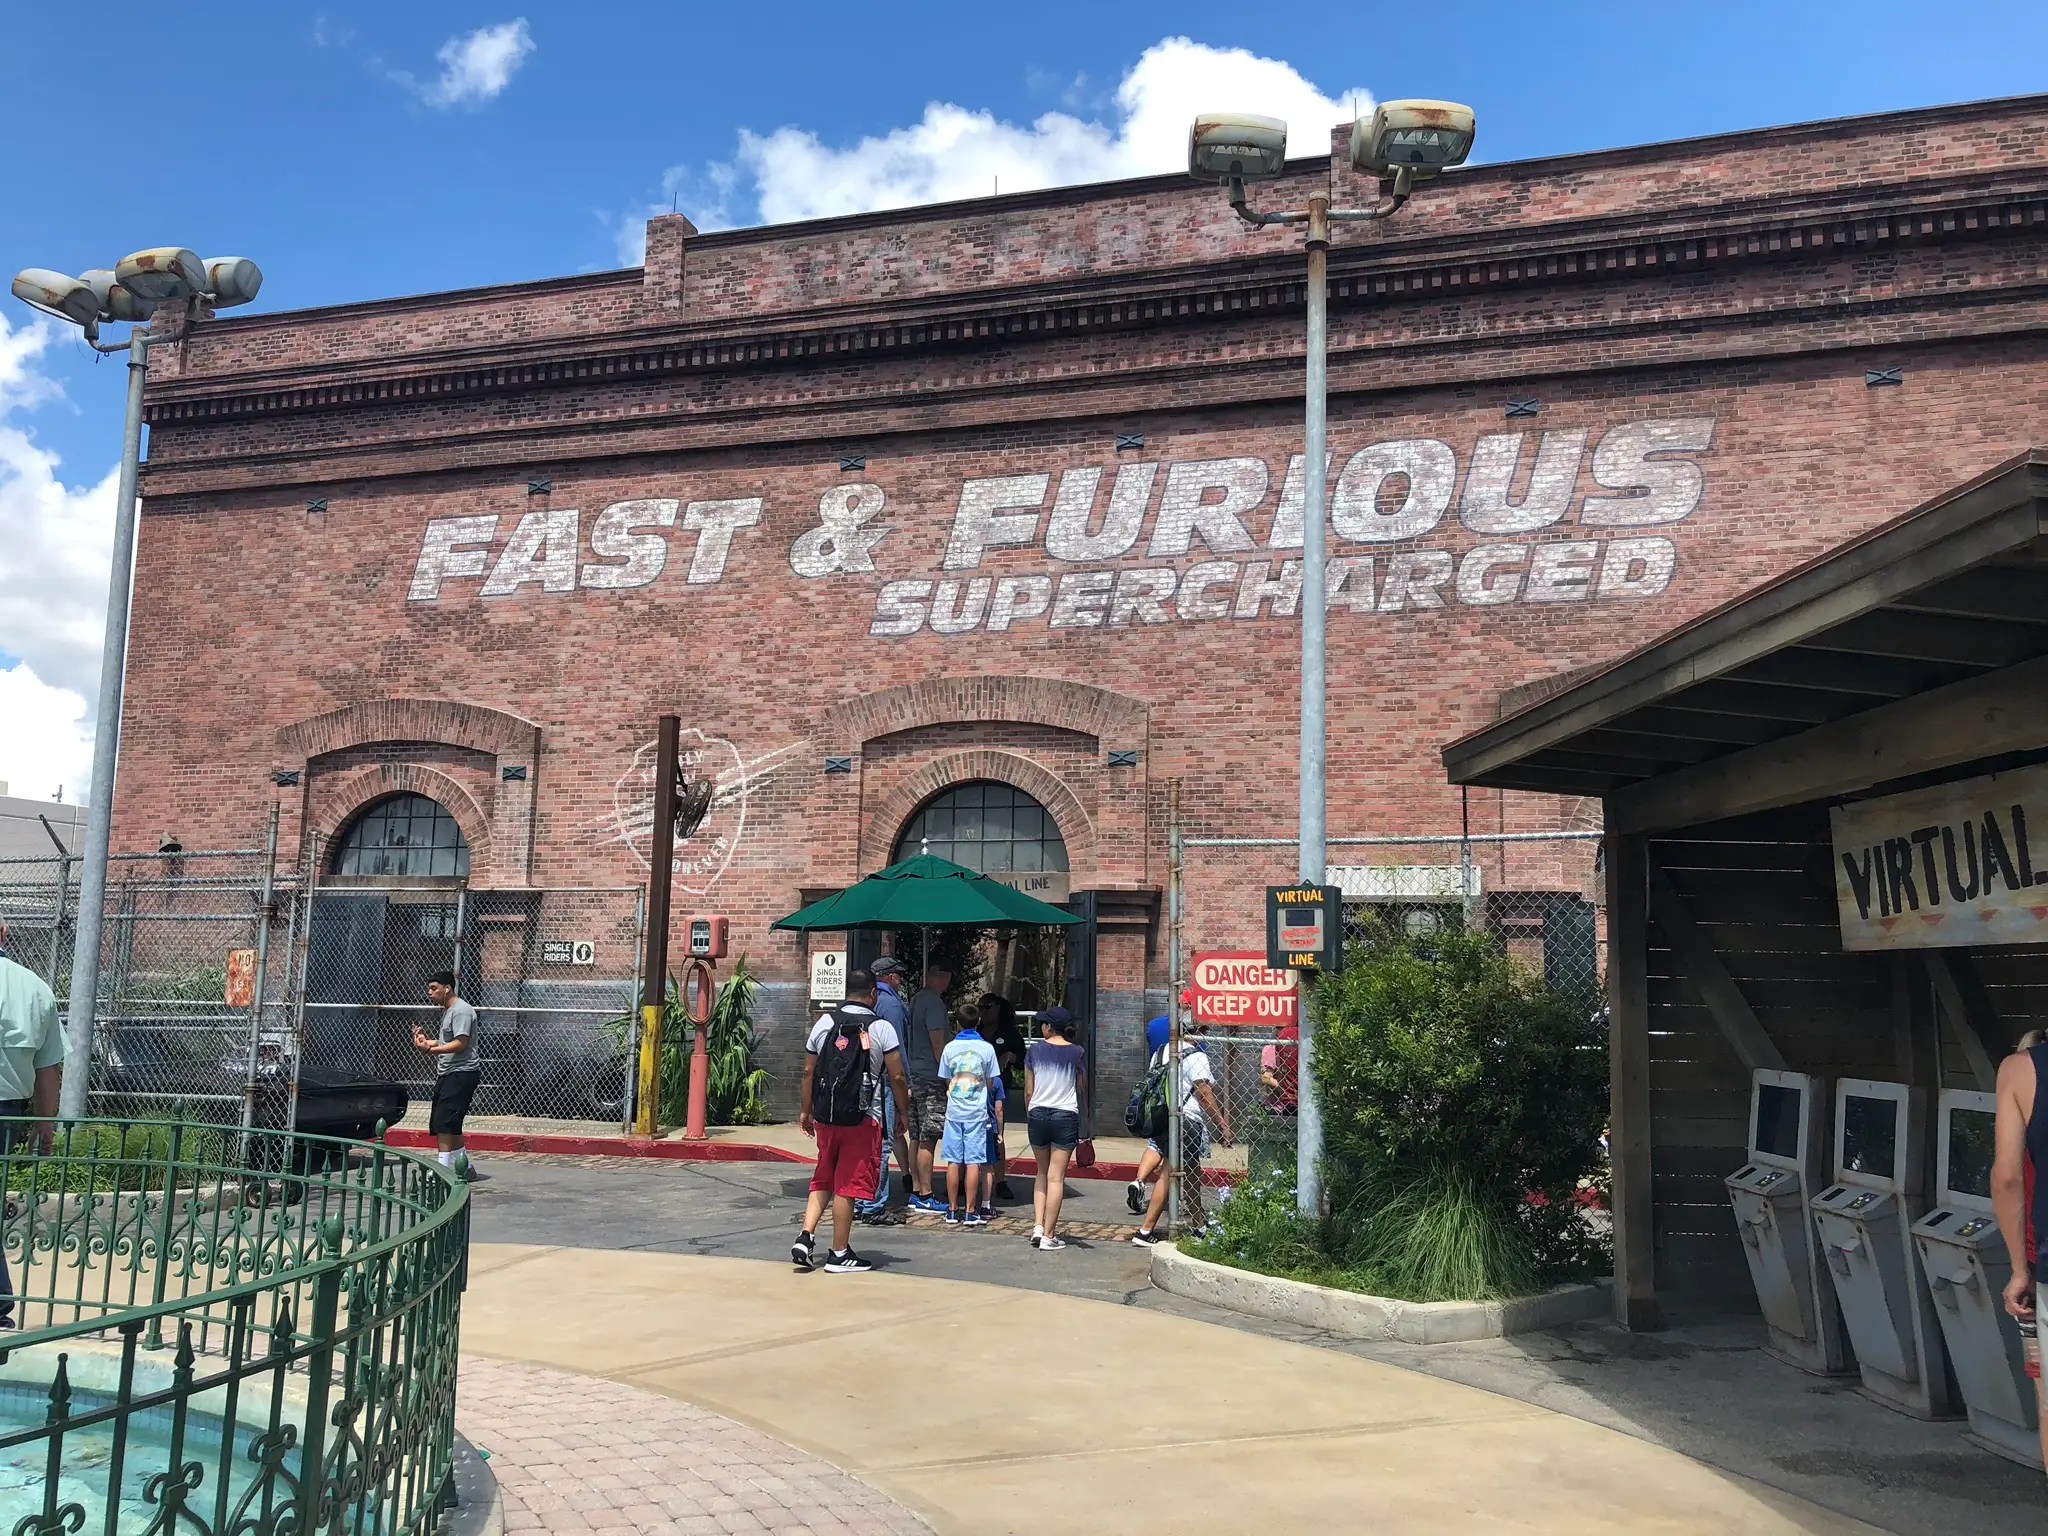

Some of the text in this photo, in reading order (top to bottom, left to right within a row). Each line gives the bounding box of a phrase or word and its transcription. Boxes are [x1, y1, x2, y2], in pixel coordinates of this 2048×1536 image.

[406, 416, 1717, 602] FAST & FURIOUS
[868, 537, 1679, 638] SUPERCHARGED
[1841, 804, 2048, 920] VIRTUAL
[1025, 876, 1050, 891] LINE
[1276, 889, 1324, 903] VIRTUAL
[544, 943, 571, 952] SINGLE
[544, 952, 571, 962] RIDERS
[1289, 953, 1314, 966] LINE
[816, 968, 843, 976] SINGLE
[1205, 964, 1287, 985] DANGER
[816, 977, 843, 985] RIDERS
[1197, 995, 1297, 1017] KEEP OUT
